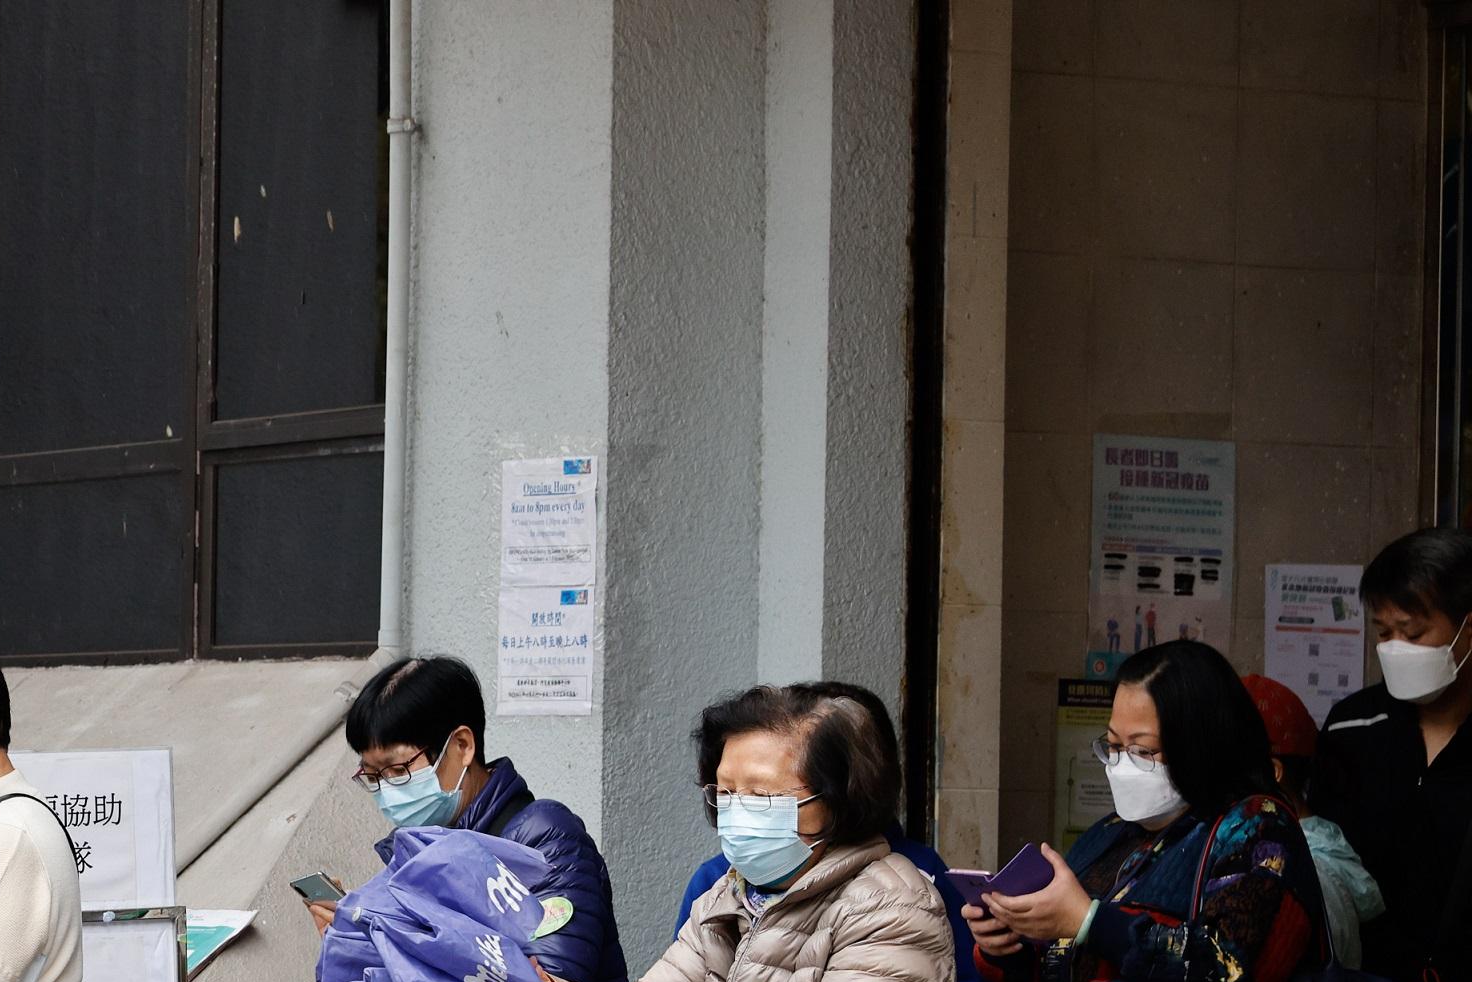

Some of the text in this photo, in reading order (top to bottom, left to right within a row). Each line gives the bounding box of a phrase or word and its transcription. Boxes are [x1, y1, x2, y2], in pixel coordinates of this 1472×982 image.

[523, 481, 575, 496] Opening Hours
[552, 502, 571, 514] every
[572, 499, 585, 514] day
[501, 634, 588, 649] 每日上午八時至晚上八時
